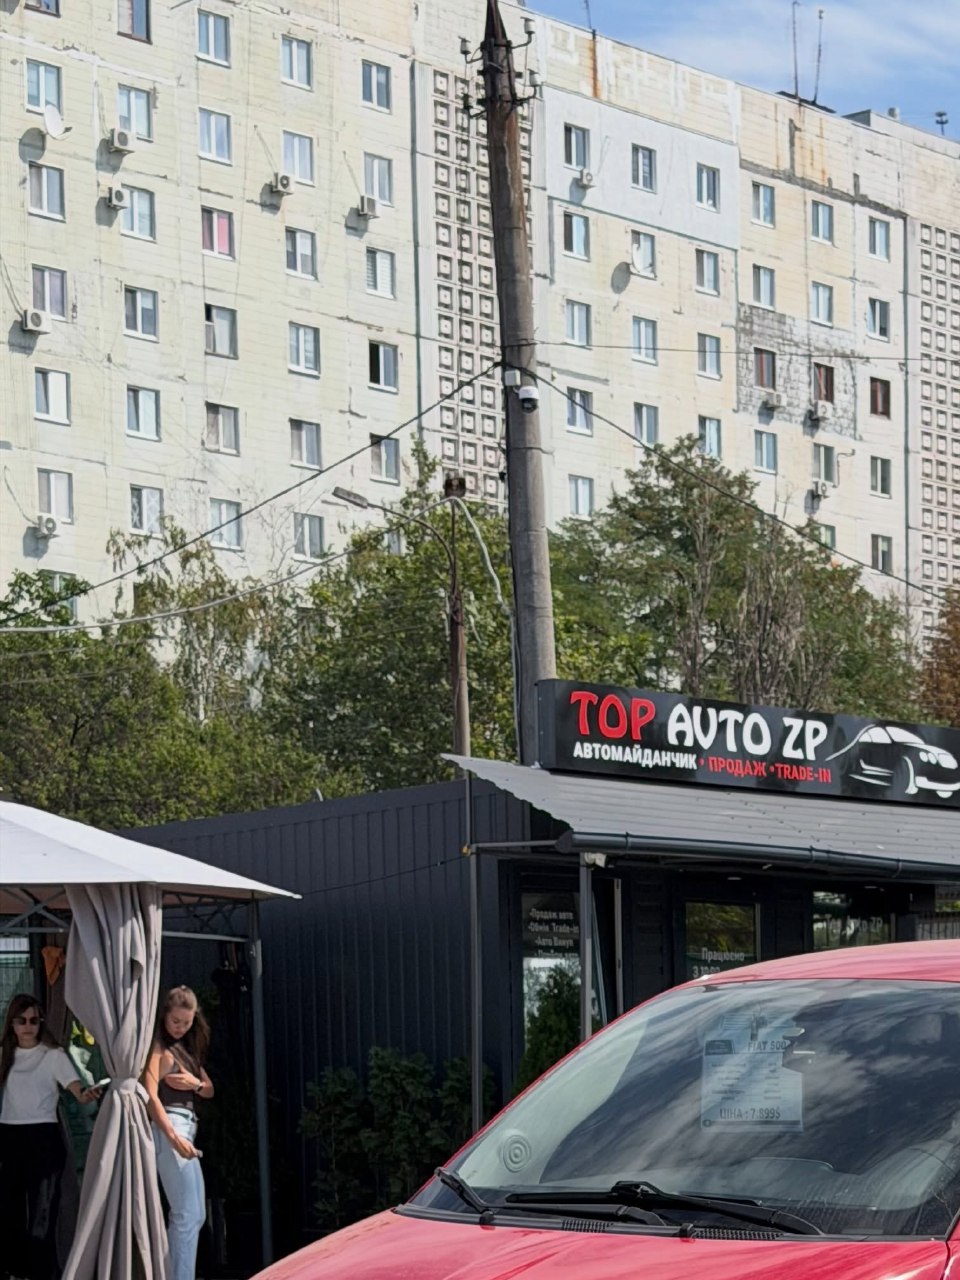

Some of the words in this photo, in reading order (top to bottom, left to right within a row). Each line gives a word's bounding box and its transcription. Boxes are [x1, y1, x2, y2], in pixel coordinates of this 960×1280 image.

[570, 691, 655, 740] TOP
[782, 717, 828, 761] ZP
[573, 741, 697, 770] АВТОМАЙДАНЧИК
[708, 756, 767, 777] ПРОДАЖ
[775, 763, 832, 783] TRADE-IN
